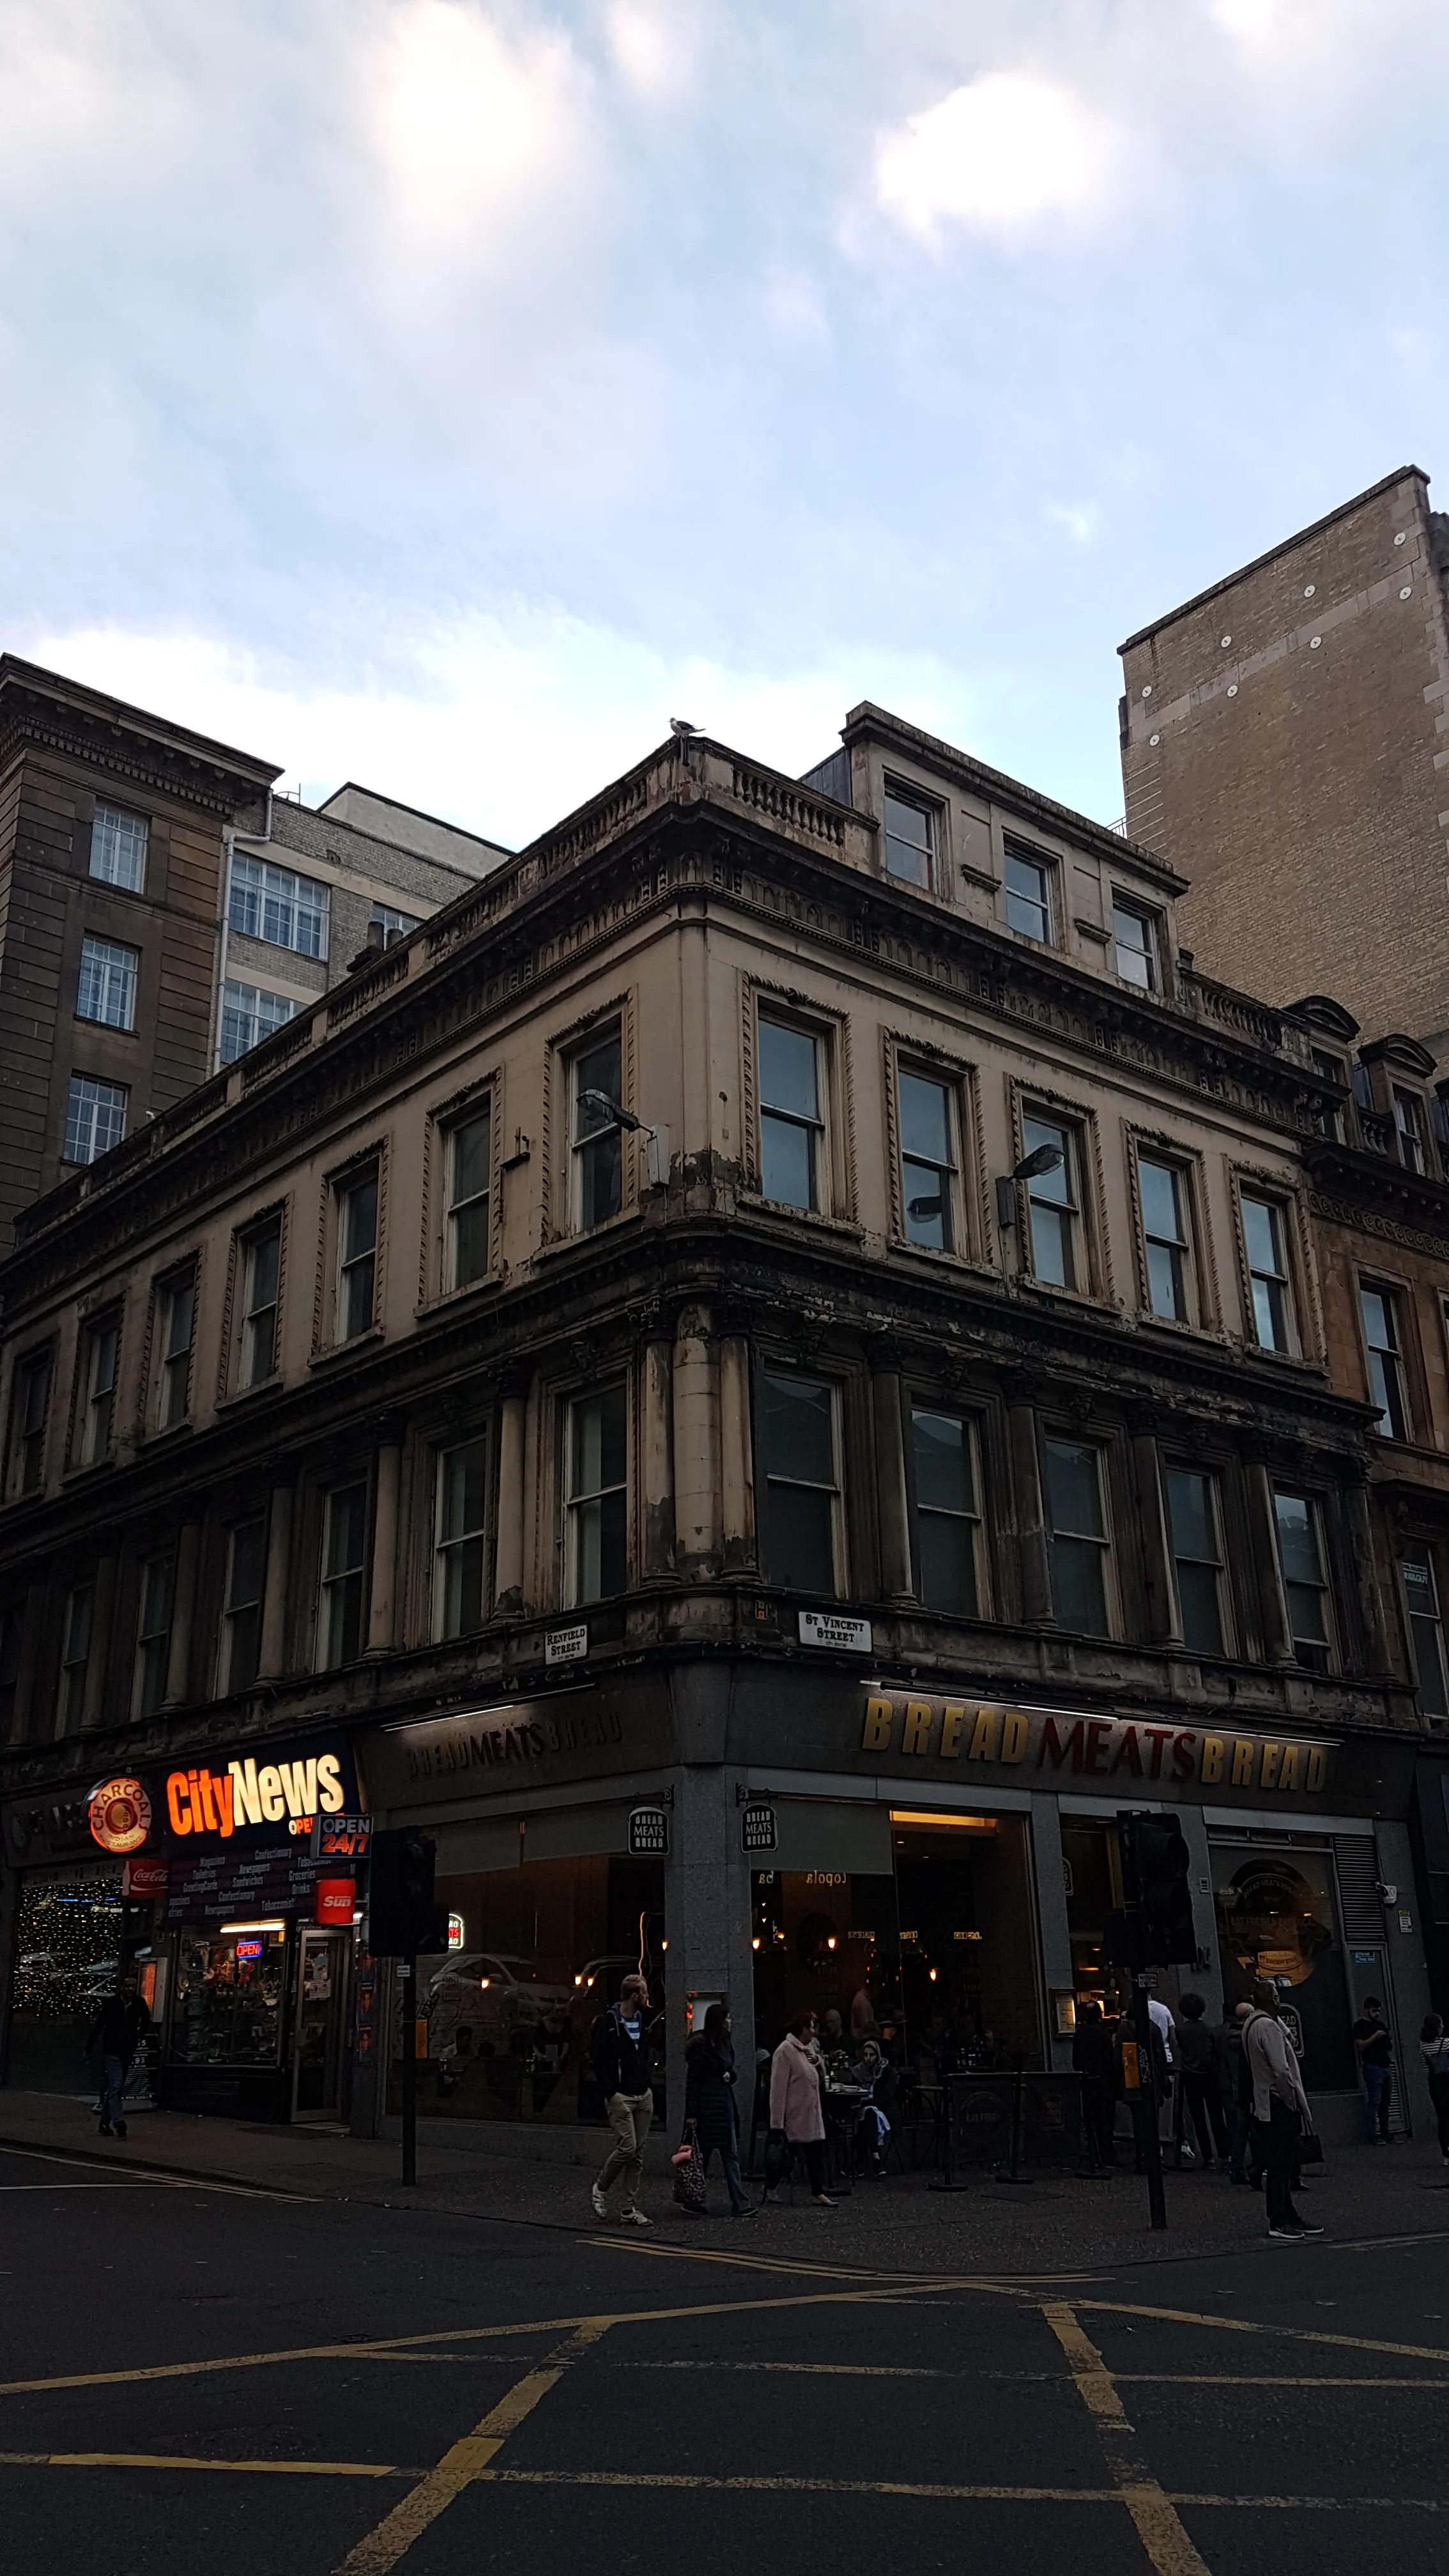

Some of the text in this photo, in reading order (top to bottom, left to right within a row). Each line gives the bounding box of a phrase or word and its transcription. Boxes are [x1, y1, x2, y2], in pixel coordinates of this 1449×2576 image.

[806, 1614, 864, 1632] ST VINCENT
[547, 1629, 585, 1646] RENFIELD
[817, 1627, 855, 1642] STREET
[551, 1641, 581, 1656] STREET
[469, 1722, 545, 1766] MEATS
[861, 1697, 1328, 1793] BREAD MEATS BREAD
[93, 1784, 151, 1831] CHARCOALS
[635, 1814, 663, 1825] BREAD
[746, 1811, 770, 1823] BREAD
[288, 1816, 314, 1835] OPE
[323, 1818, 370, 1834] OPEN
[633, 1825, 664, 1837] MEATS
[746, 1821, 772, 1834] MEATS
[321, 1832, 369, 1855] 24/7
[635, 1837, 663, 1848] BREAD
[747, 1834, 771, 1846] BREAD
[323, 1896, 351, 1907] Sun
[236, 1943, 258, 1956] OPEN
